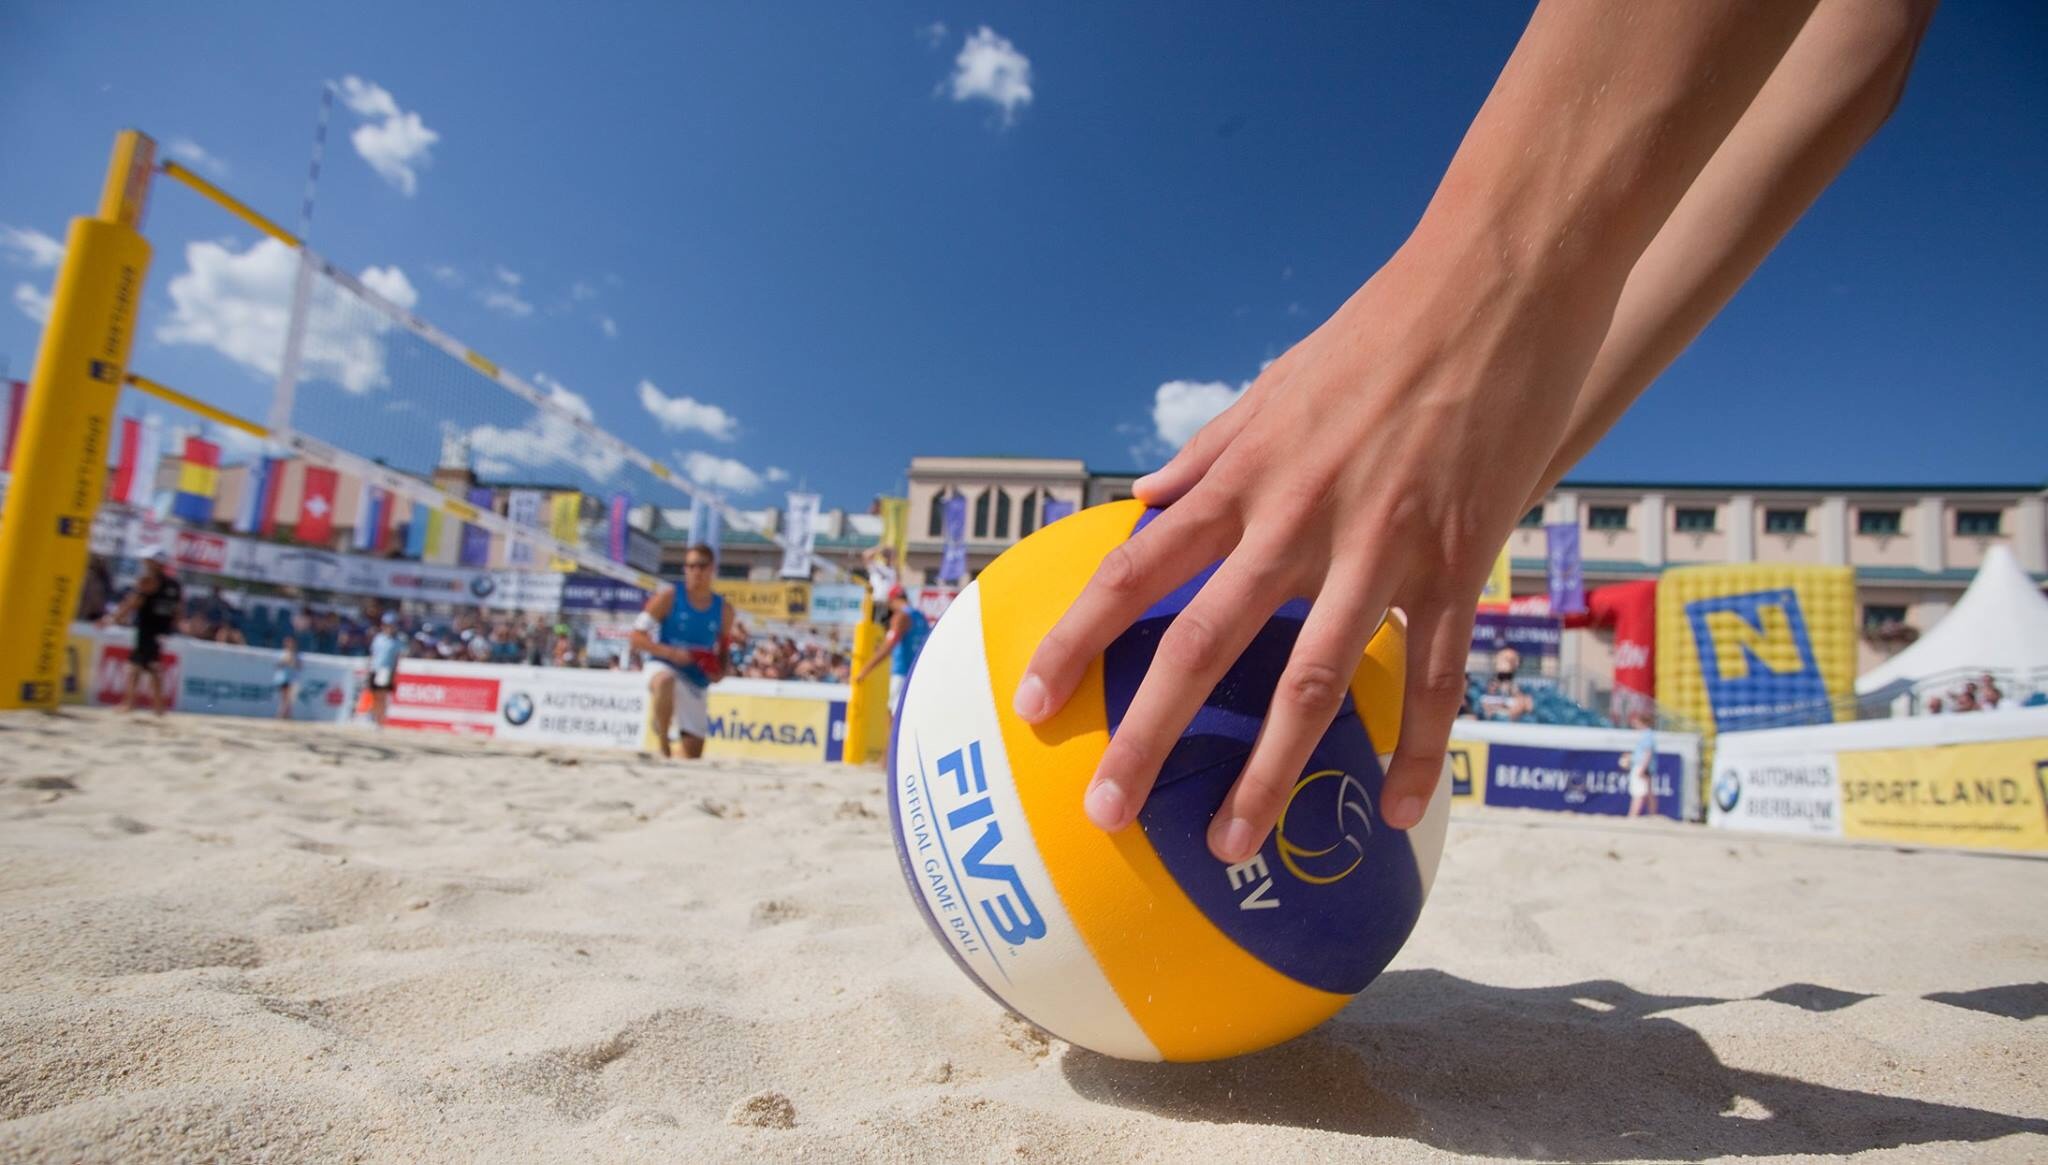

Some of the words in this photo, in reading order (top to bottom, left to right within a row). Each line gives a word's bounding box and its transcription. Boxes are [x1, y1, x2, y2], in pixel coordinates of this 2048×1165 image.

[1704, 602, 1804, 682] N
[543, 692, 643, 713] AUTOHAUS
[540, 716, 641, 737] BIERBAUM
[1748, 765, 1831, 788] AUTOHAUS
[1746, 797, 1832, 820] BIERBAUM
[937, 740, 1047, 946] FIVB
[905, 774, 933, 856] OFFICIAL
[924, 858, 959, 914] GAME
[950, 916, 980, 956] BALL
[1225, 852, 1281, 912] EV
